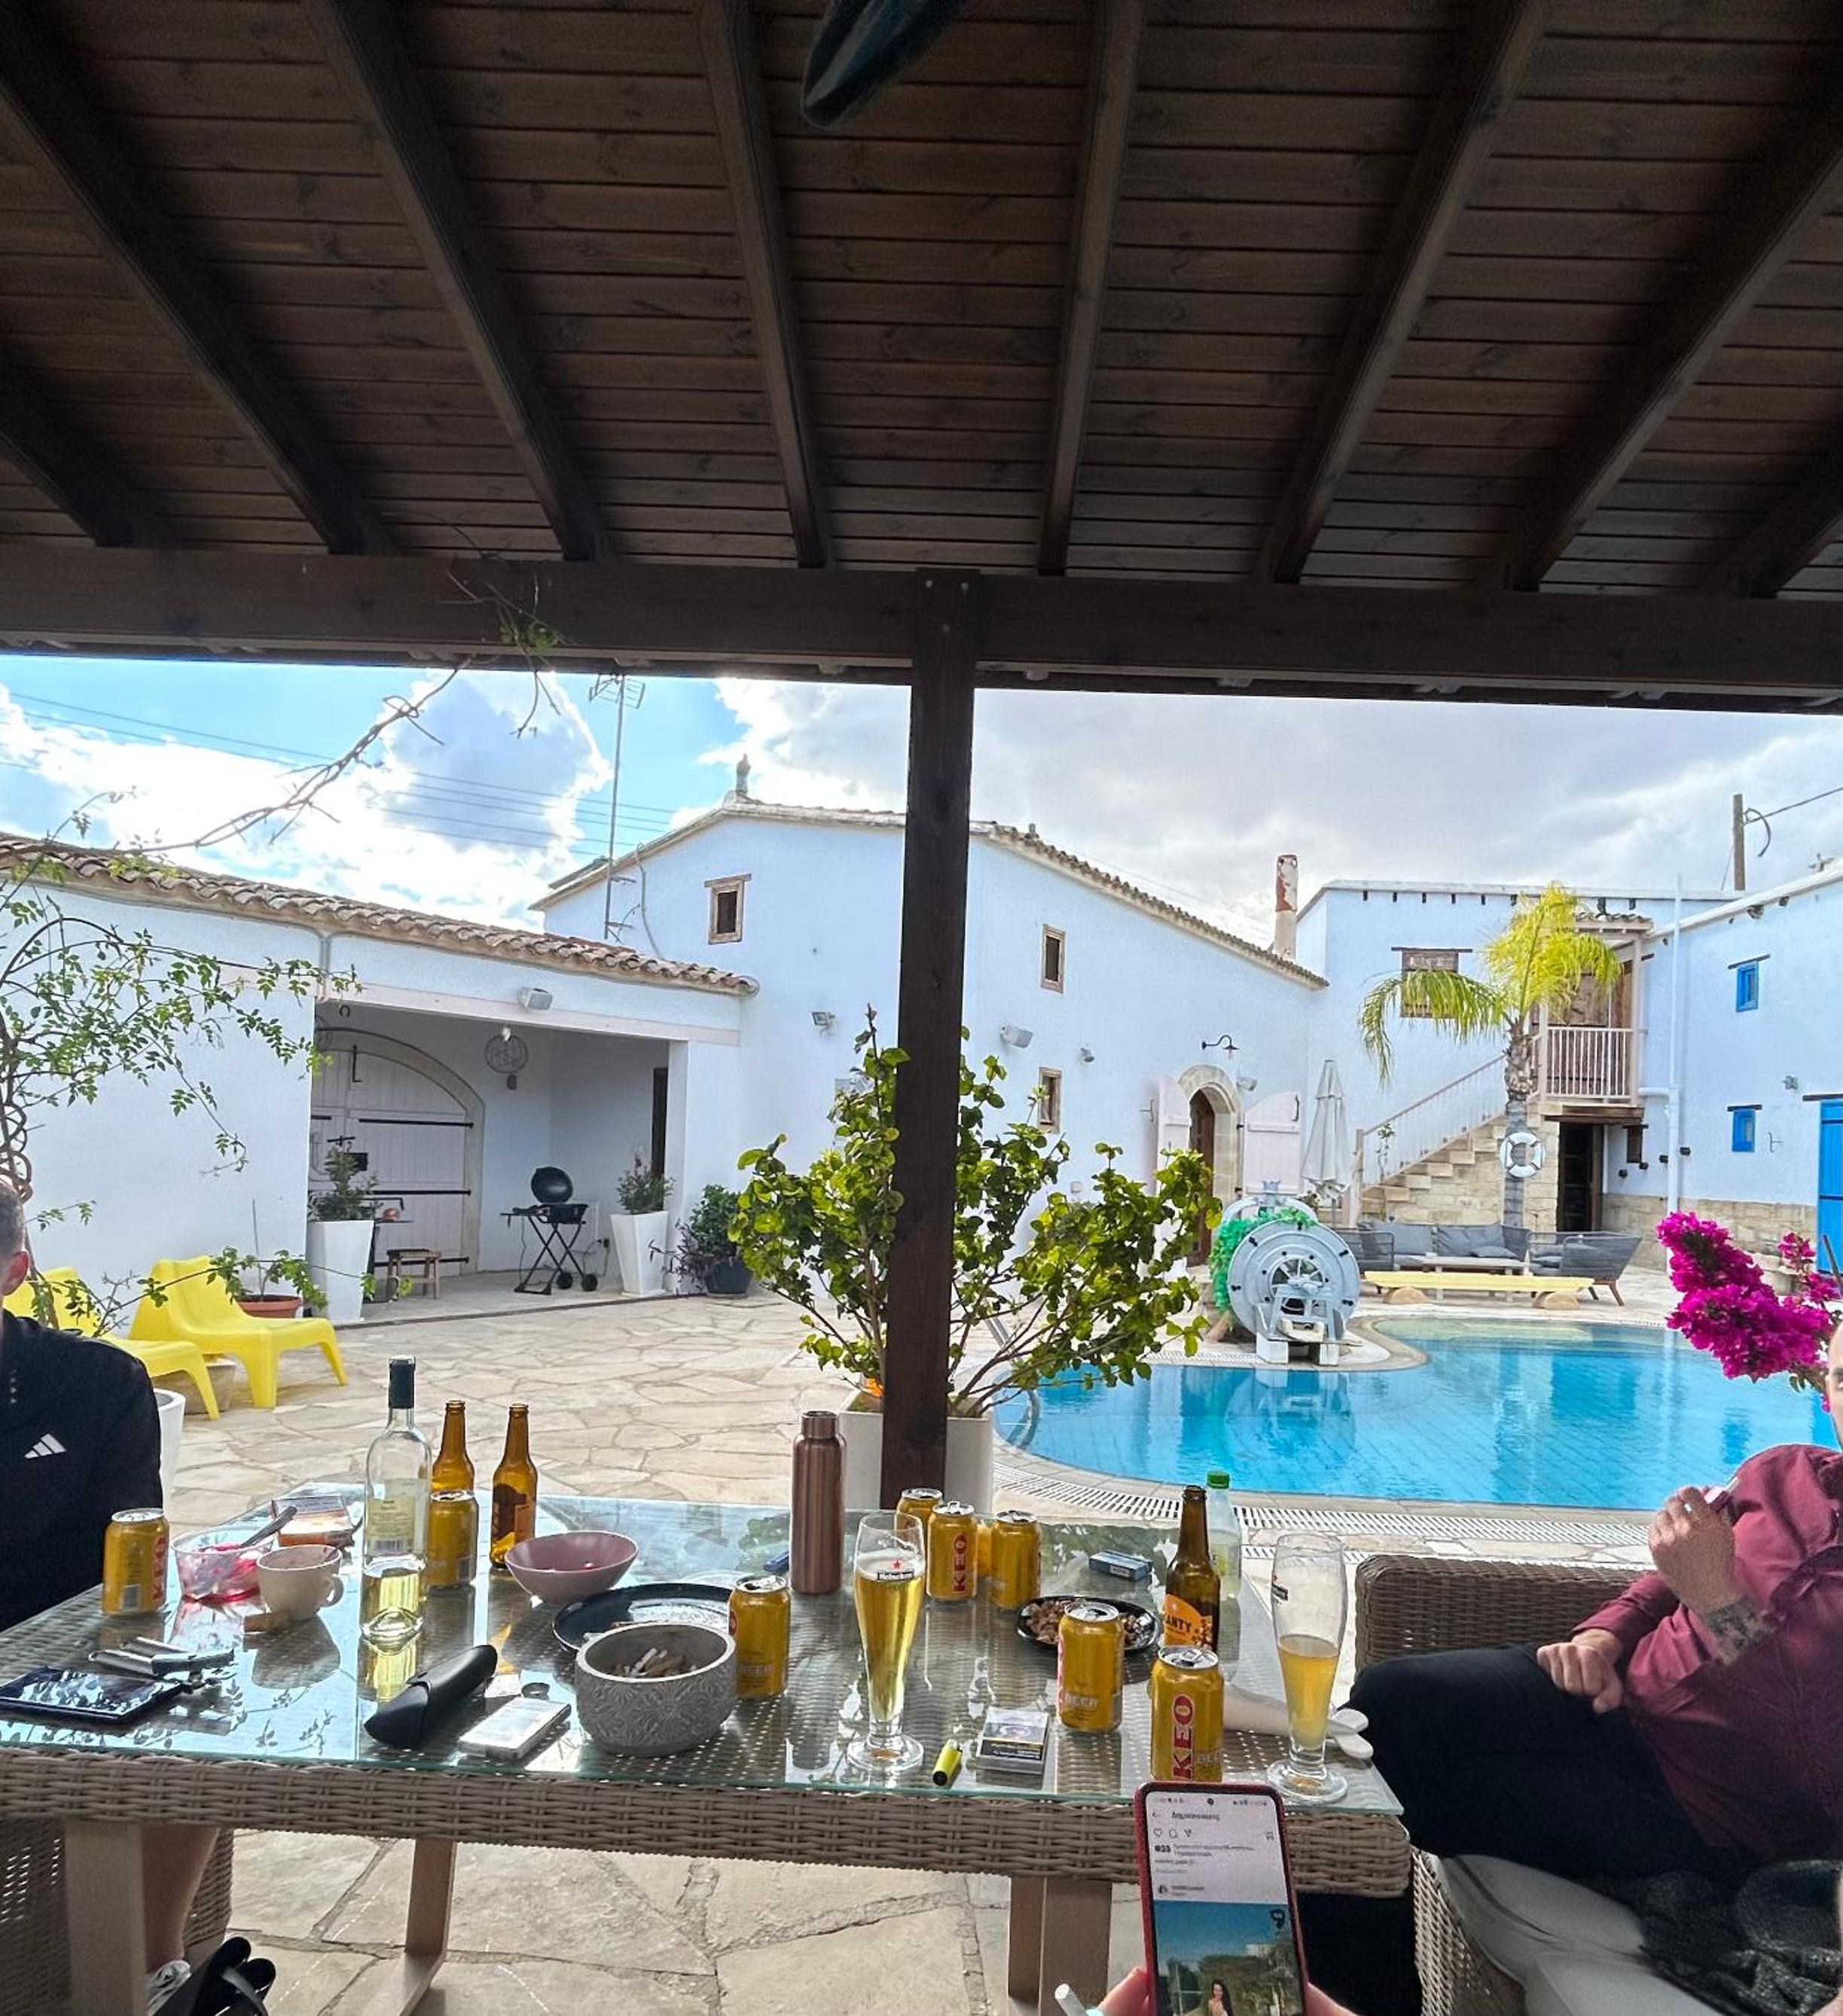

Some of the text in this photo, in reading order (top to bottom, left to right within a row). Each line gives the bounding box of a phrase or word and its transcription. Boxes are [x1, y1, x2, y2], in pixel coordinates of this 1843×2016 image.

[954, 1534, 967, 1591] KEO
[1164, 1612, 1192, 1633] ANTY
[1173, 1694, 1193, 1779] KEO
